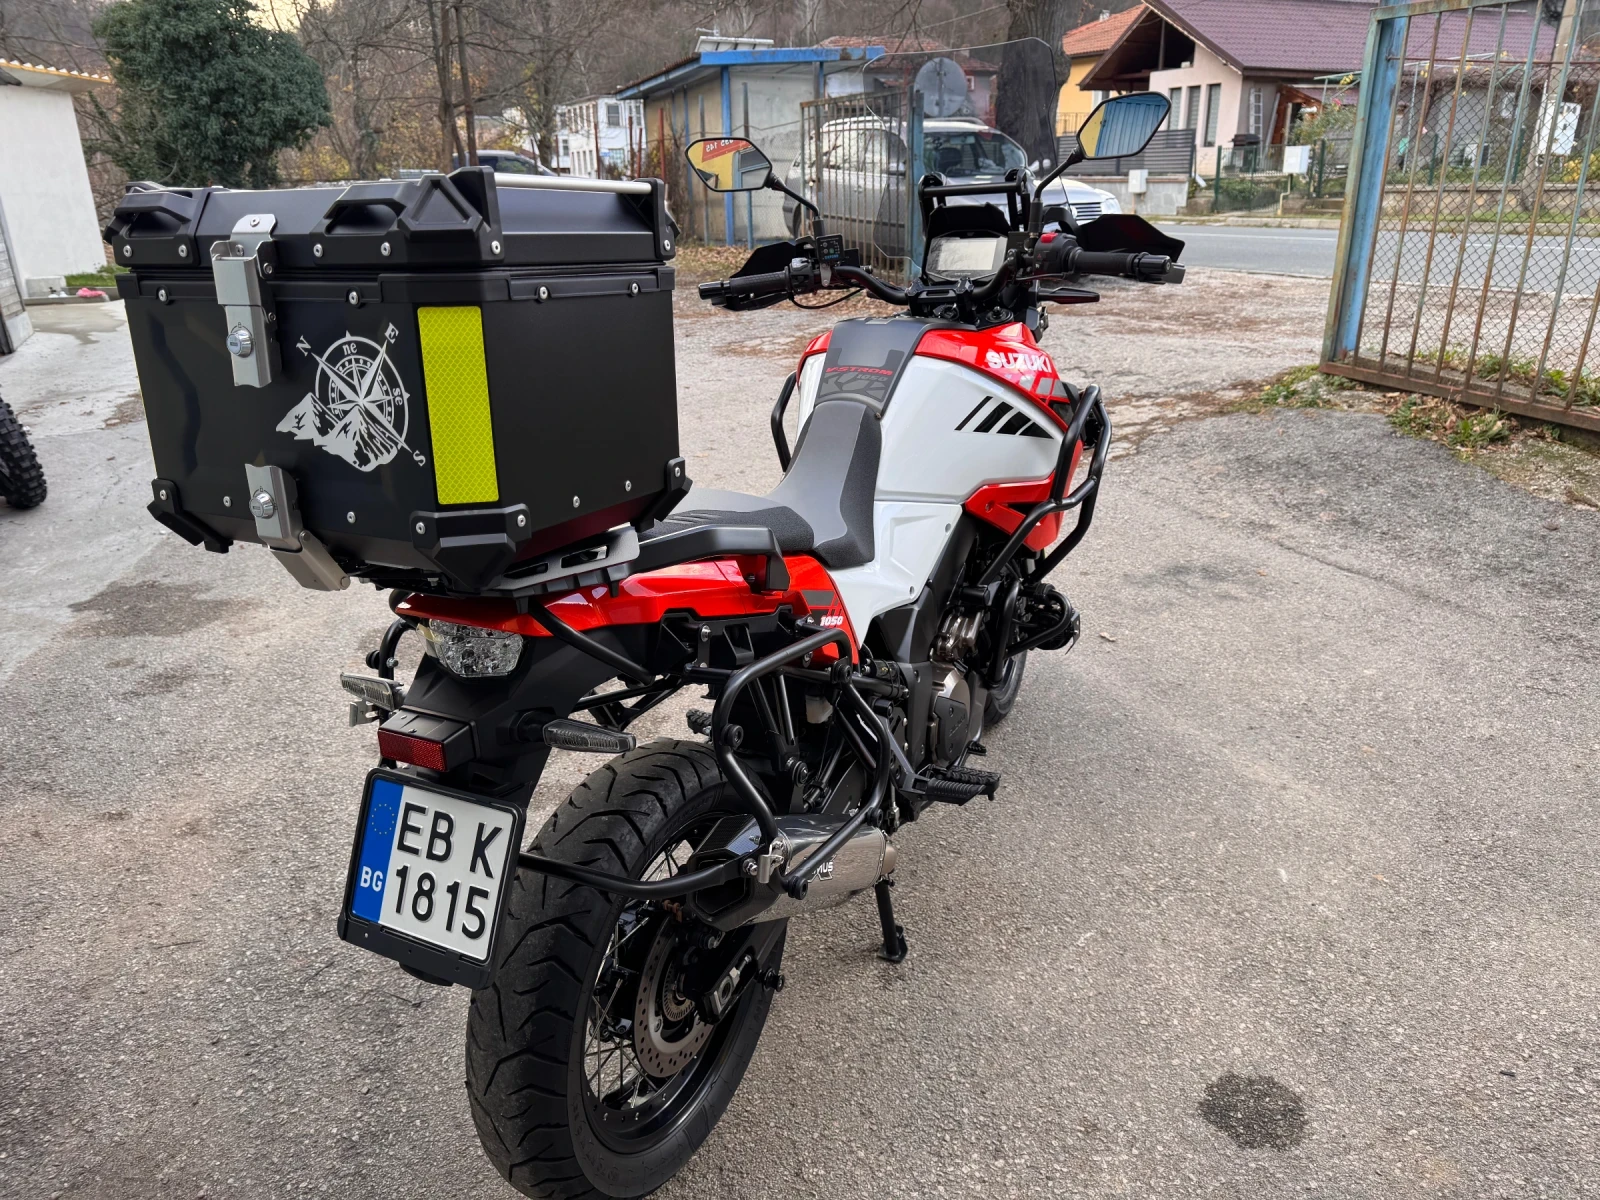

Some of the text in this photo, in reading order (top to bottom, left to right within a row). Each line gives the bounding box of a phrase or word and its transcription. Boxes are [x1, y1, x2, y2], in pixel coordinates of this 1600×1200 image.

[384, 322, 399, 344] E
[296, 335, 311, 357] N
[342, 342, 358, 356] ne
[986, 351, 1052, 373] SUZUKI
[856, 373, 889, 382] 1050
[412, 450, 427, 467] S
[820, 615, 844, 627] 1050
[397, 802, 503, 879] EB K
[360, 866, 384, 892] BG
[395, 864, 490, 940] 1815
